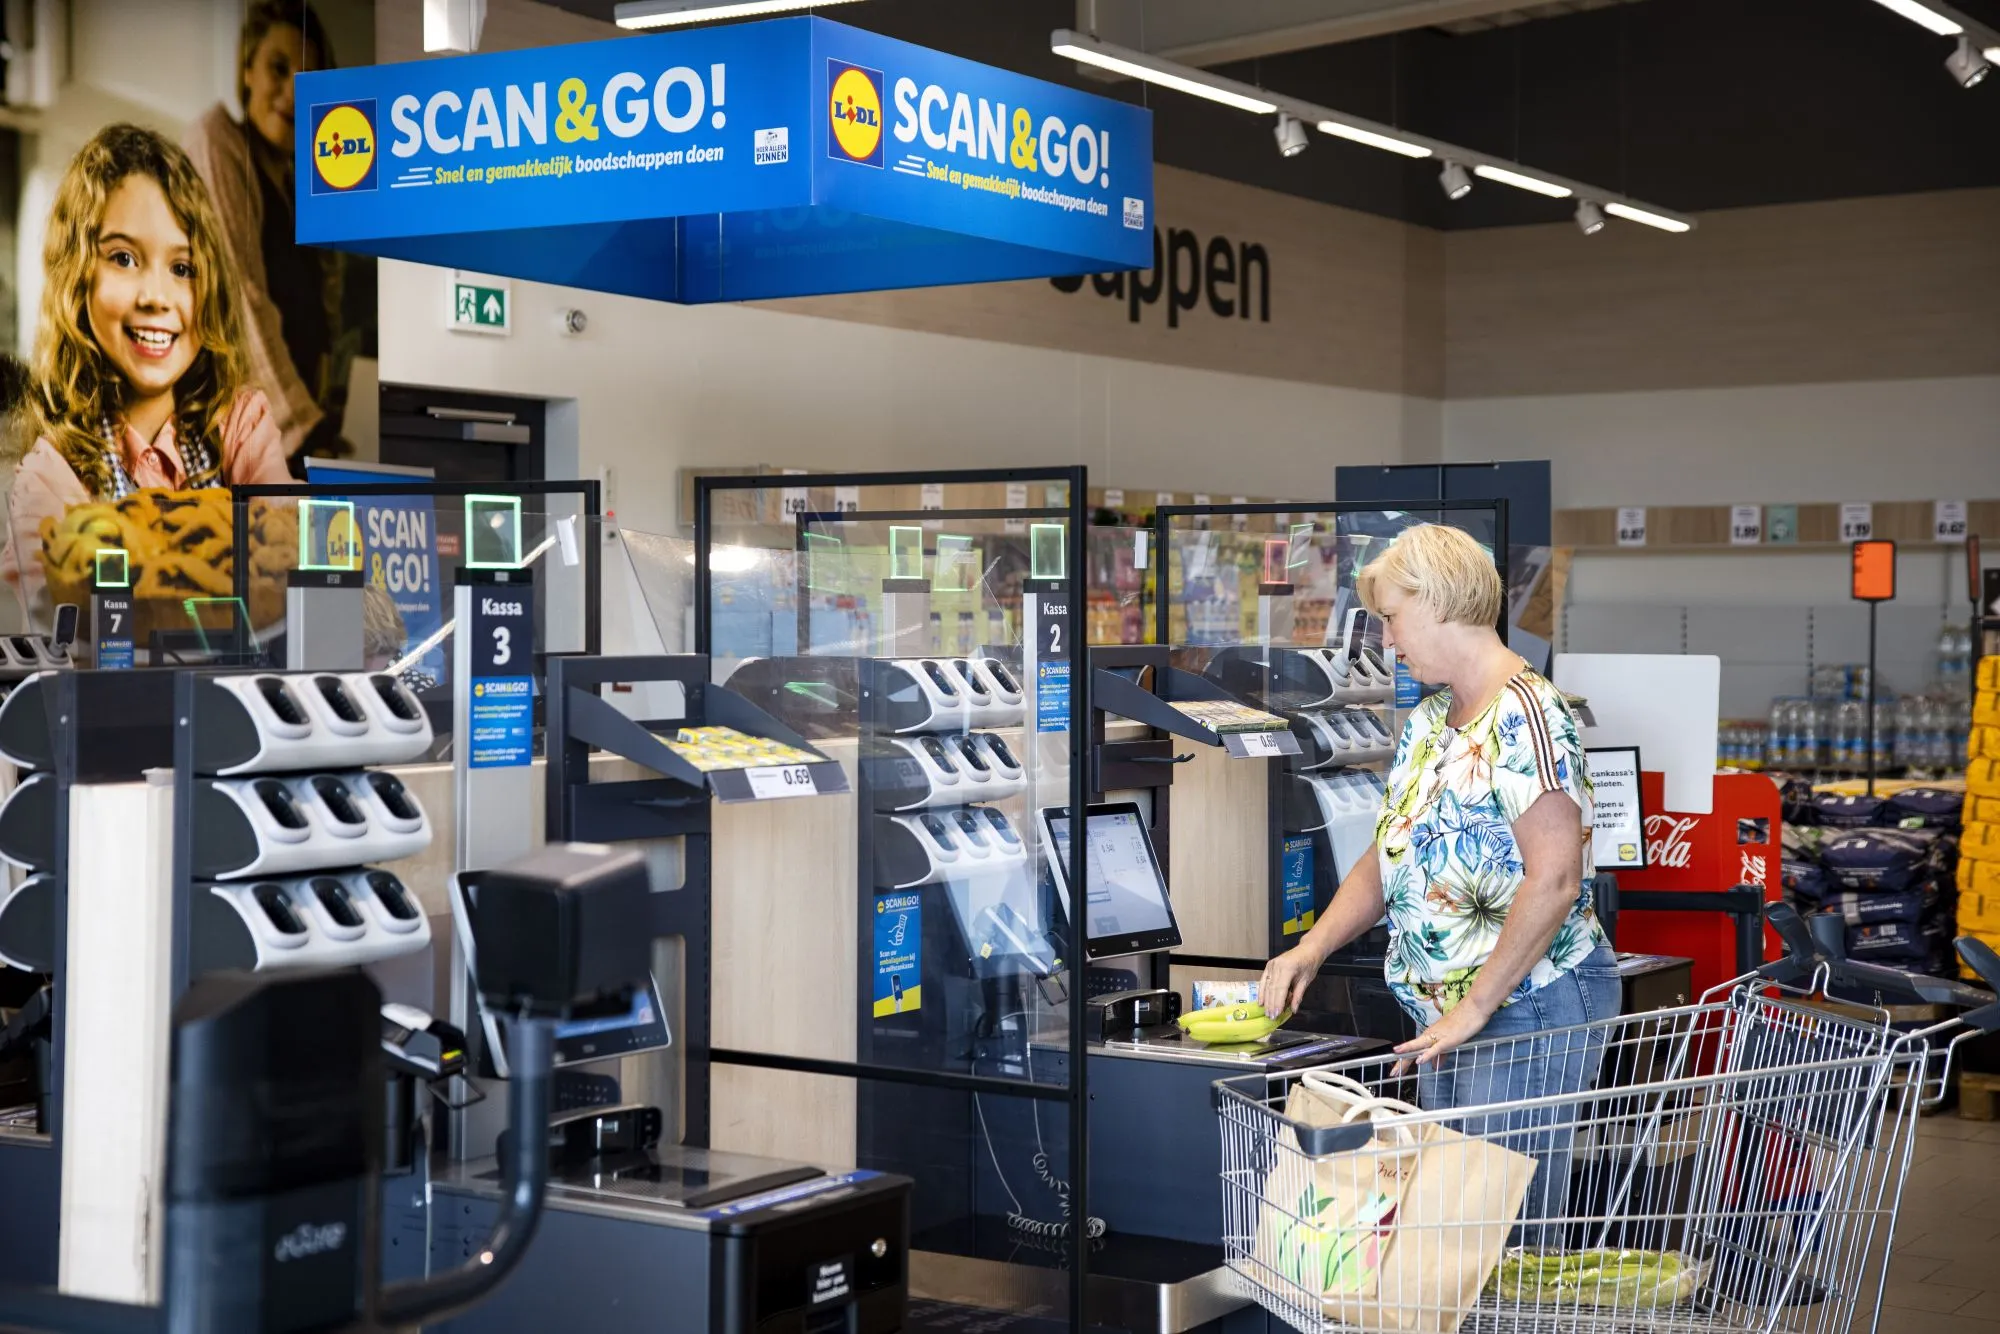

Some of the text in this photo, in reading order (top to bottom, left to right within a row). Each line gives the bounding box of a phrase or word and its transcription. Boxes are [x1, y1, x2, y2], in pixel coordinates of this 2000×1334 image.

[391, 63, 726, 158] SCAN&GO!
[893, 76, 1109, 189] SCAN&GO!
[435, 144, 724, 184] Snel en gemakkelijk boodschappen doen
[756, 151, 787, 162] PINNEN
[926, 161, 1108, 216] Snel en gemakkelijk boodschappen doen
[368, 507, 427, 549] SCAN
[371, 551, 430, 594] &GO!
[104, 599, 128, 609] Kassa
[482, 597, 523, 616] Kassa
[1043, 602, 1068, 615] Kassa
[110, 613, 122, 634] 7
[1050, 623, 1061, 653] 2
[492, 626, 511, 666] 3
[783, 768, 810, 785] 0.69
[885, 895, 919, 909] SCAN&GO!
